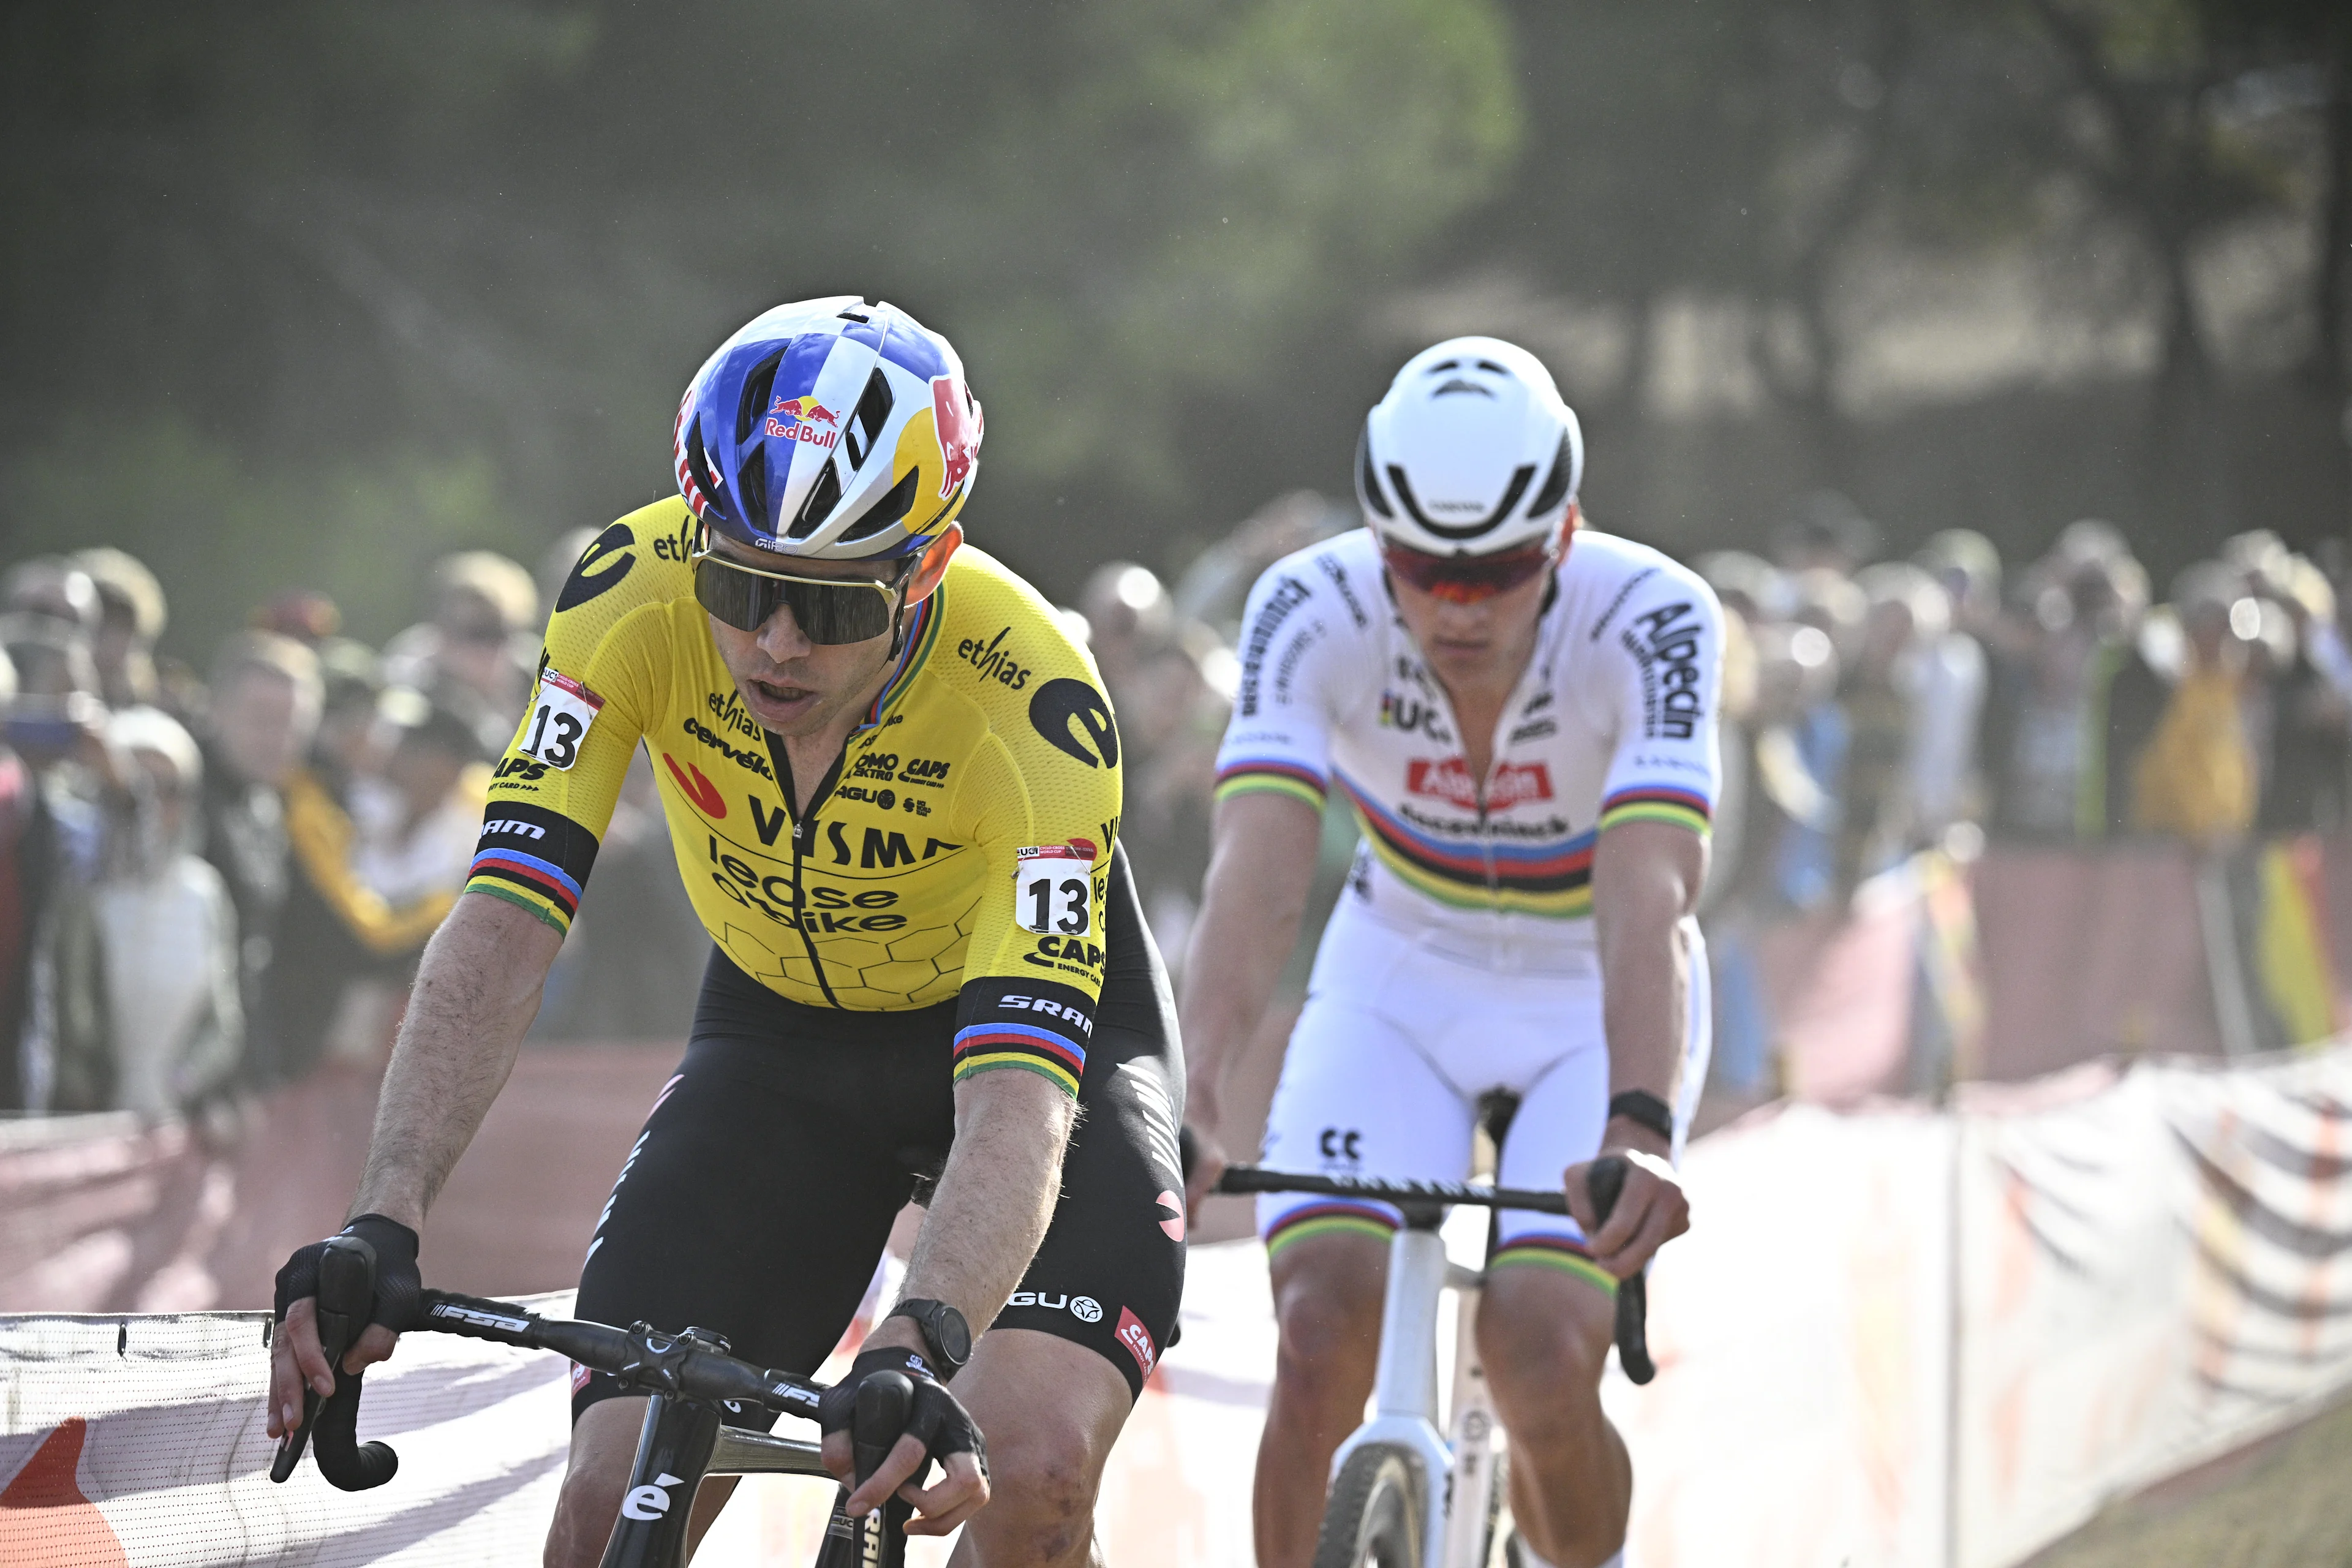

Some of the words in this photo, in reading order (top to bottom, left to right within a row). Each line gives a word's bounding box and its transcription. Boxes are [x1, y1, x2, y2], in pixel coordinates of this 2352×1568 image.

[764, 418, 801, 440] Red
[799, 425, 836, 449] Bull
[755, 538, 797, 554] GIRO
[958, 627, 1031, 690] ethias
[557, 674, 579, 687] CYCLO-CROSS
[709, 688, 761, 742] ethias
[529, 705, 583, 768] 13
[684, 718, 774, 781] cervélo
[907, 759, 951, 780] CAPS
[834, 785, 878, 804] AGU
[480, 820, 546, 840] AM
[709, 834, 899, 909] lease
[712, 872, 751, 909] a
[1029, 878, 1089, 935] 13
[1038, 936, 1106, 976] CAPS
[1058, 963, 1090, 978] ENERGY
[1129, 1324, 1154, 1375] CAPS
[1133, 1344, 1145, 1362] ENERGY
[622, 1472, 685, 1521] é
